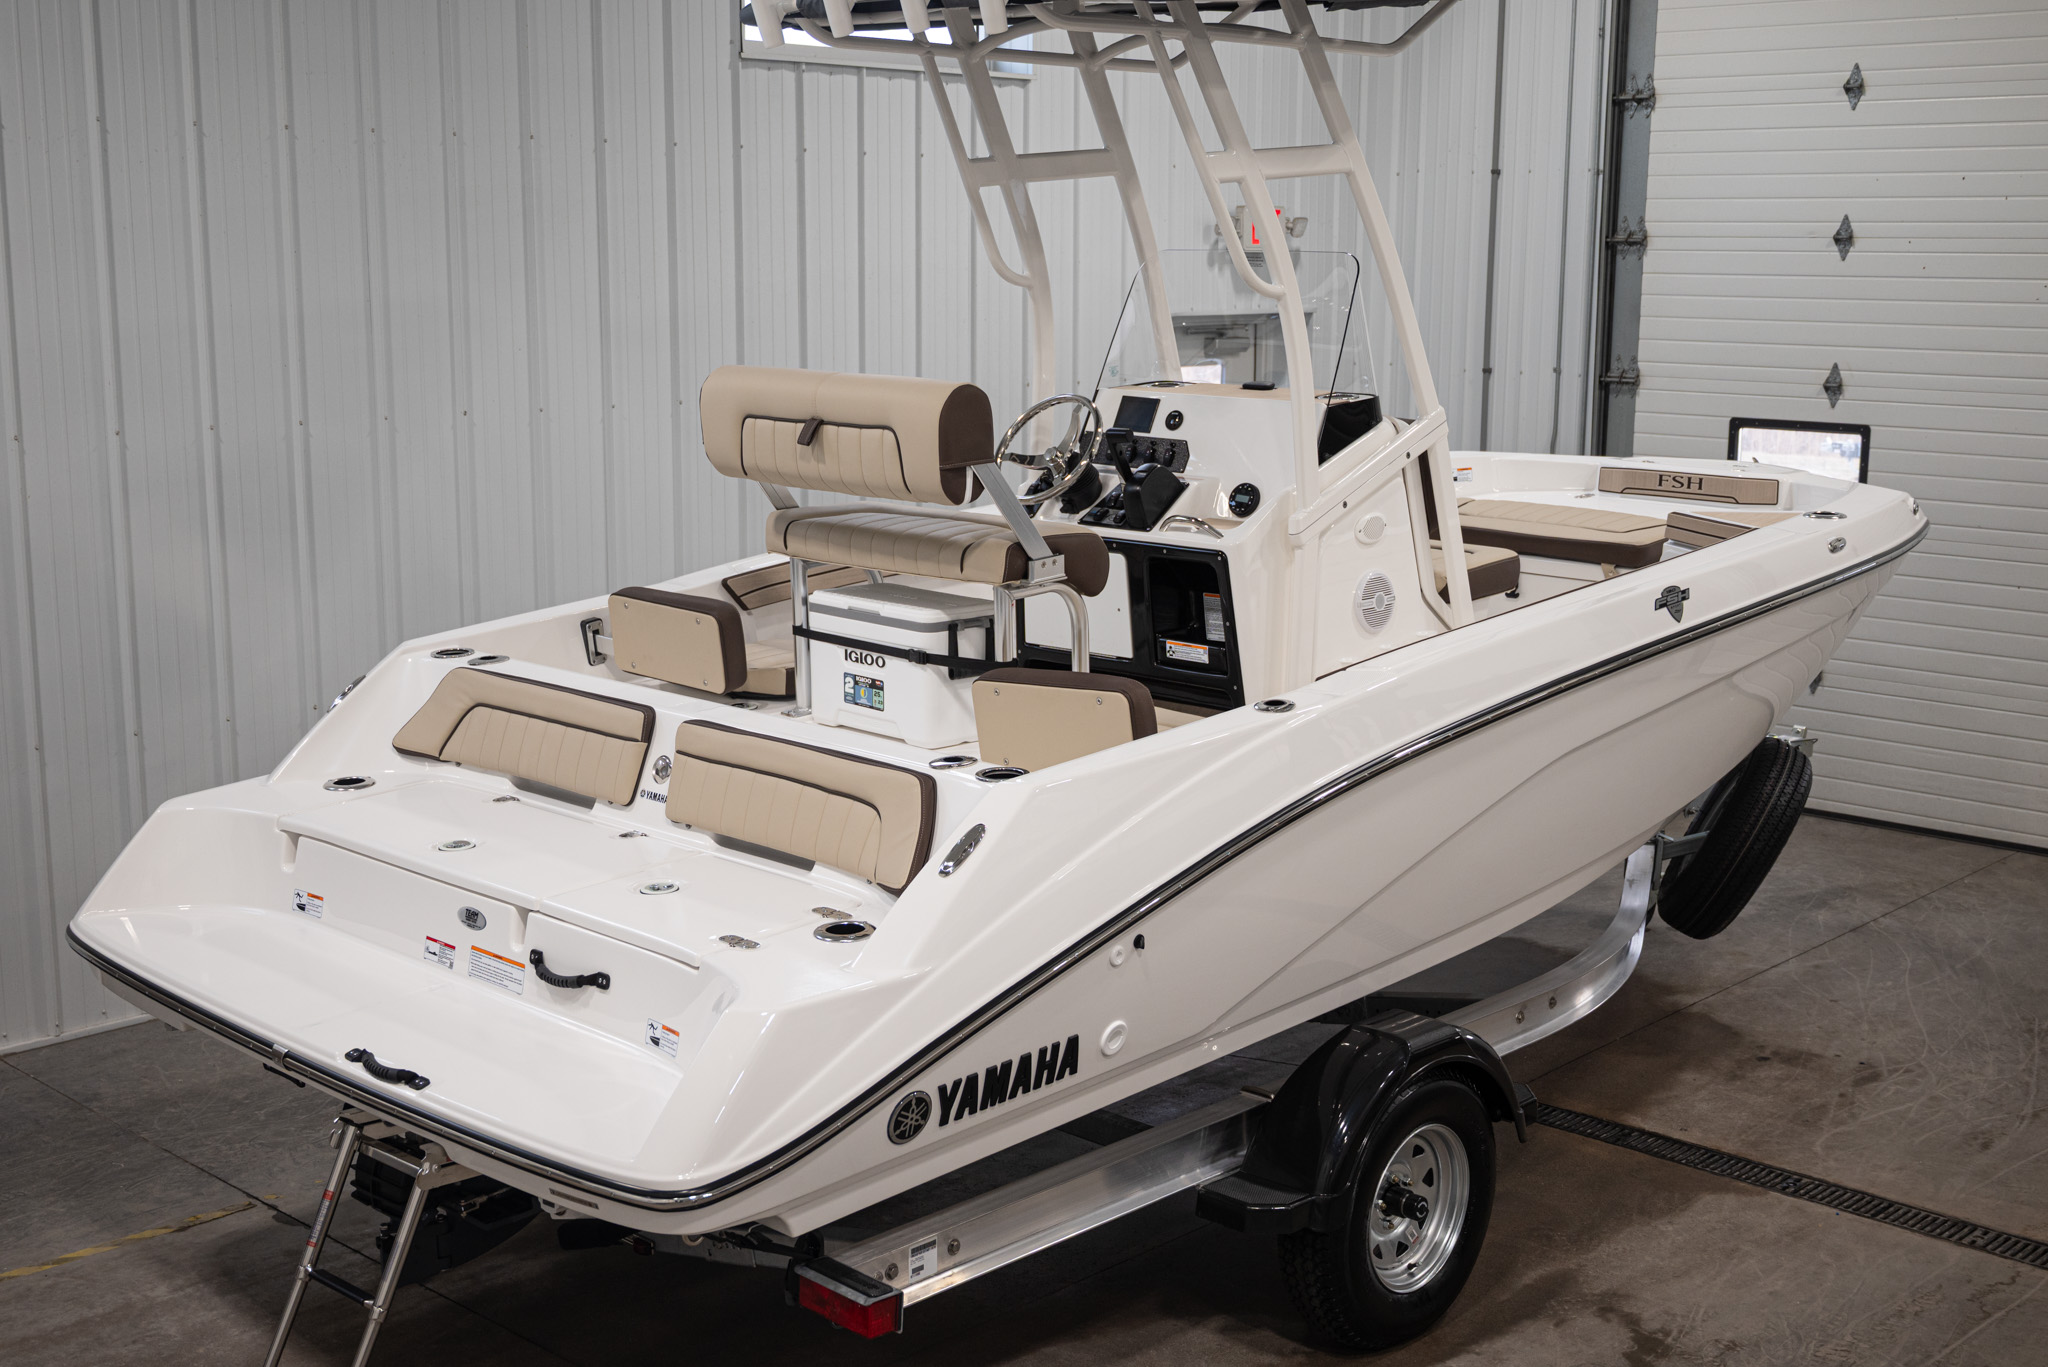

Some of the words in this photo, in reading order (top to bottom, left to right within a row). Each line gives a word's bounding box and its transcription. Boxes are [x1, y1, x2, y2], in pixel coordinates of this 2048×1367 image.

[1657, 474, 1703, 491] FSH
[1655, 589, 1689, 610] FSH
[845, 649, 886, 668] IGLOO
[844, 676, 855, 694] 2
[937, 1034, 1079, 1127] YAMAHA
